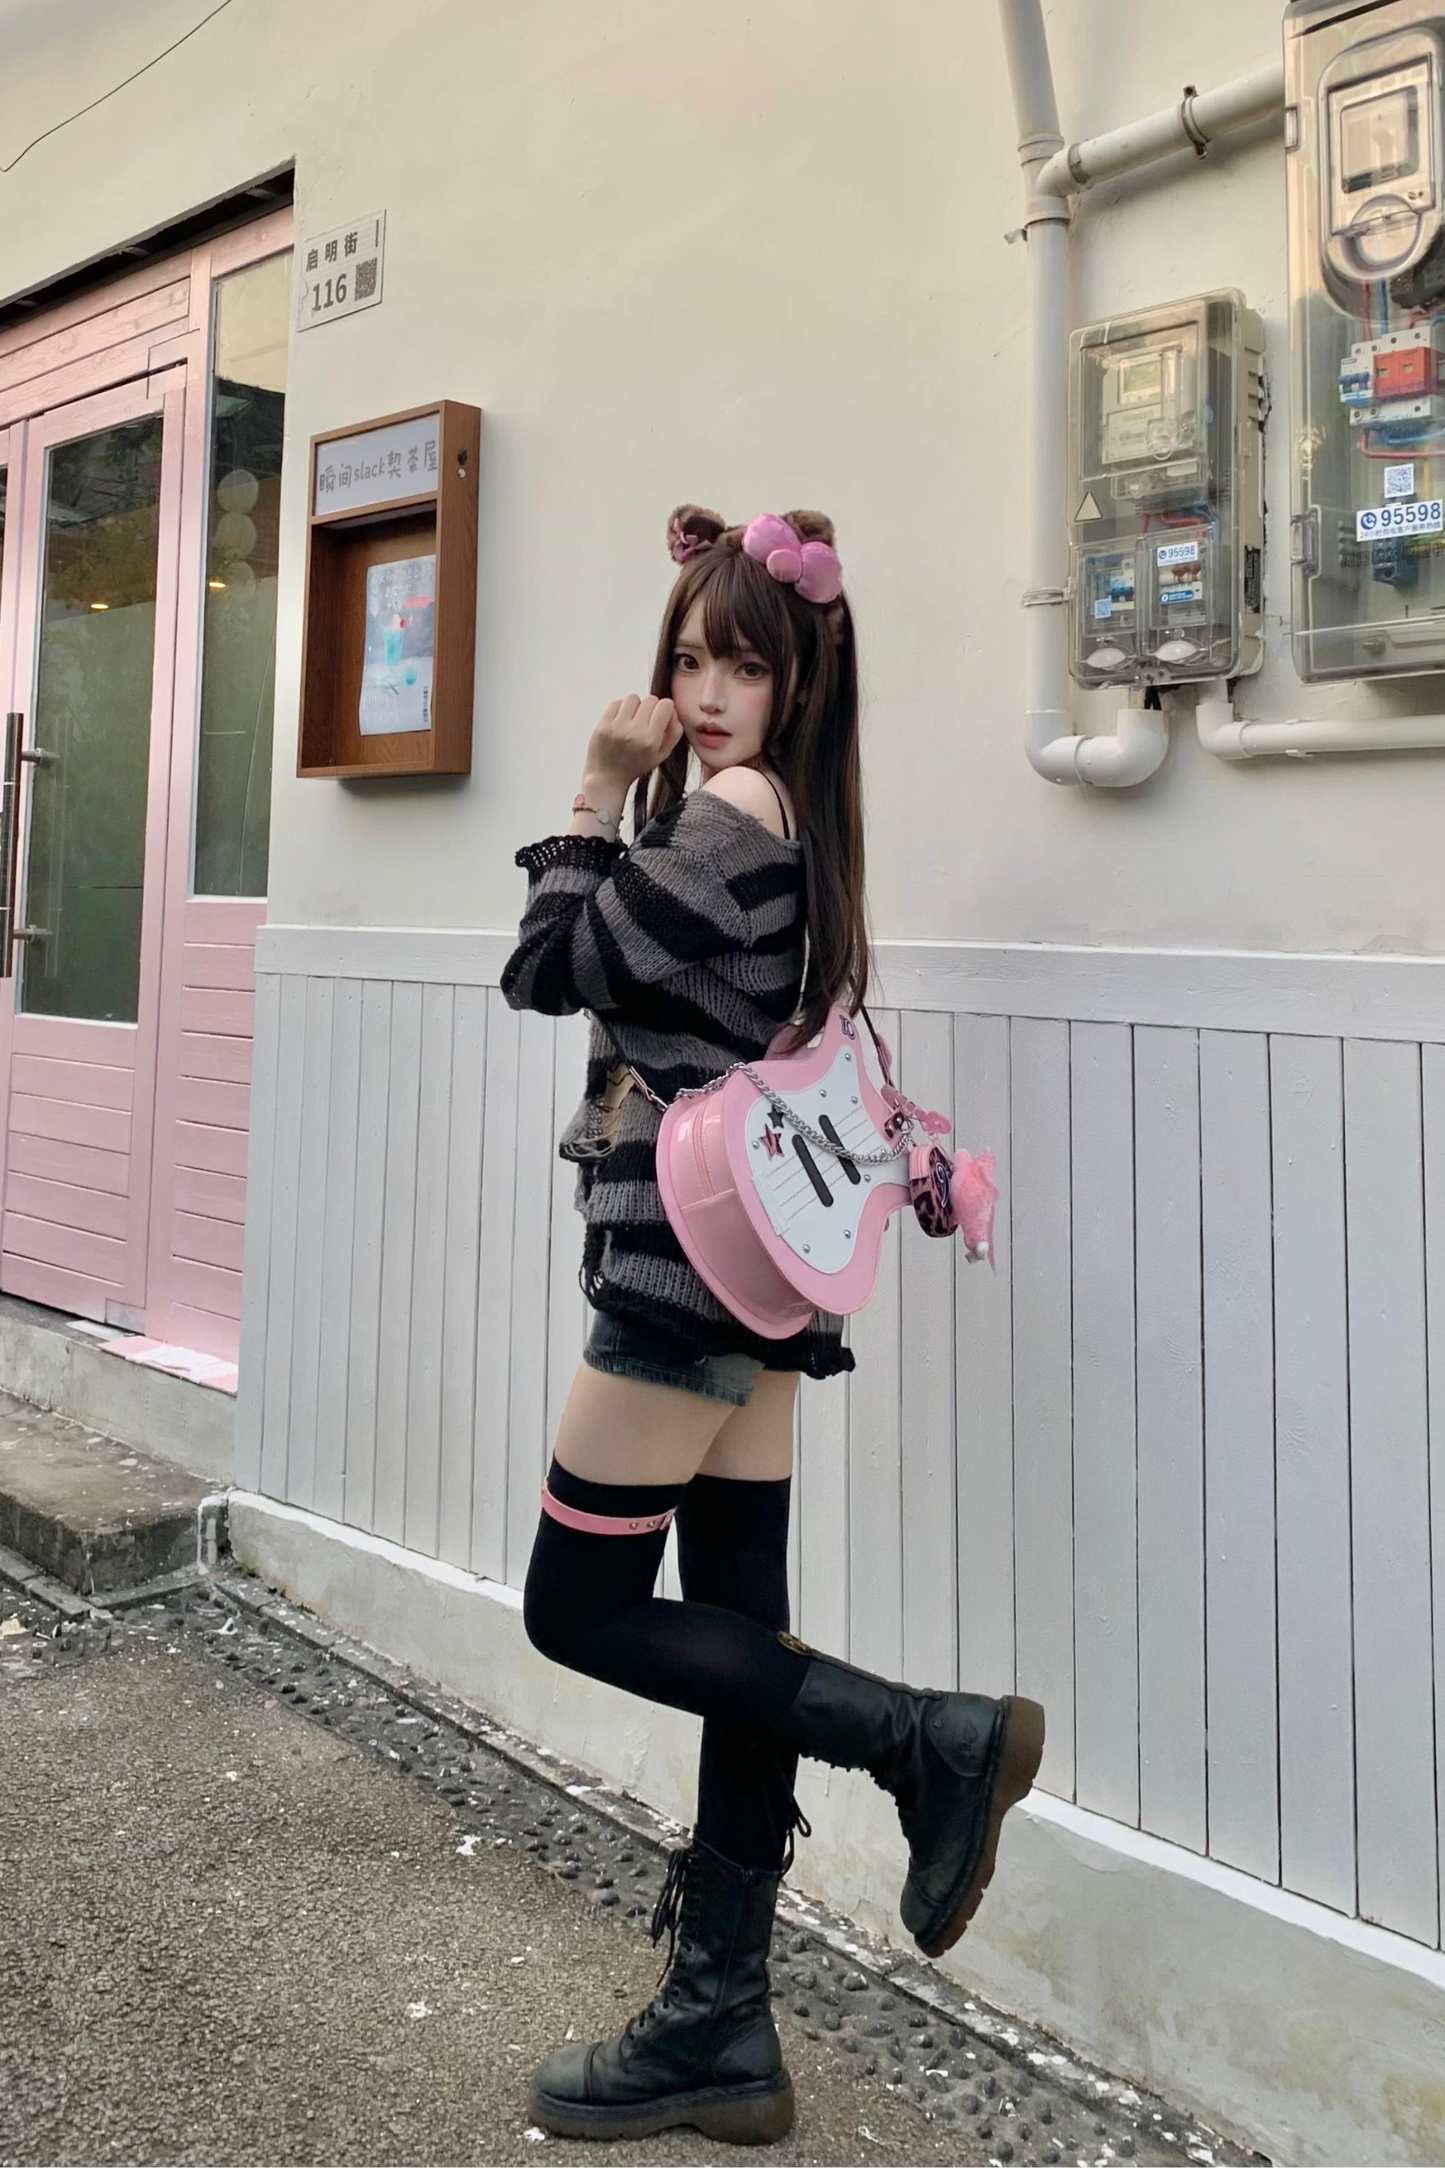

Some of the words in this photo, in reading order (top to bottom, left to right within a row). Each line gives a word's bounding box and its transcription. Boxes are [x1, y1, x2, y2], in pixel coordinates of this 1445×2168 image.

[306, 231, 358, 272] 启明街
[311, 273, 347, 312] 116
[1381, 502, 1441, 527] 95598
[1168, 545, 1196, 558] 95598
